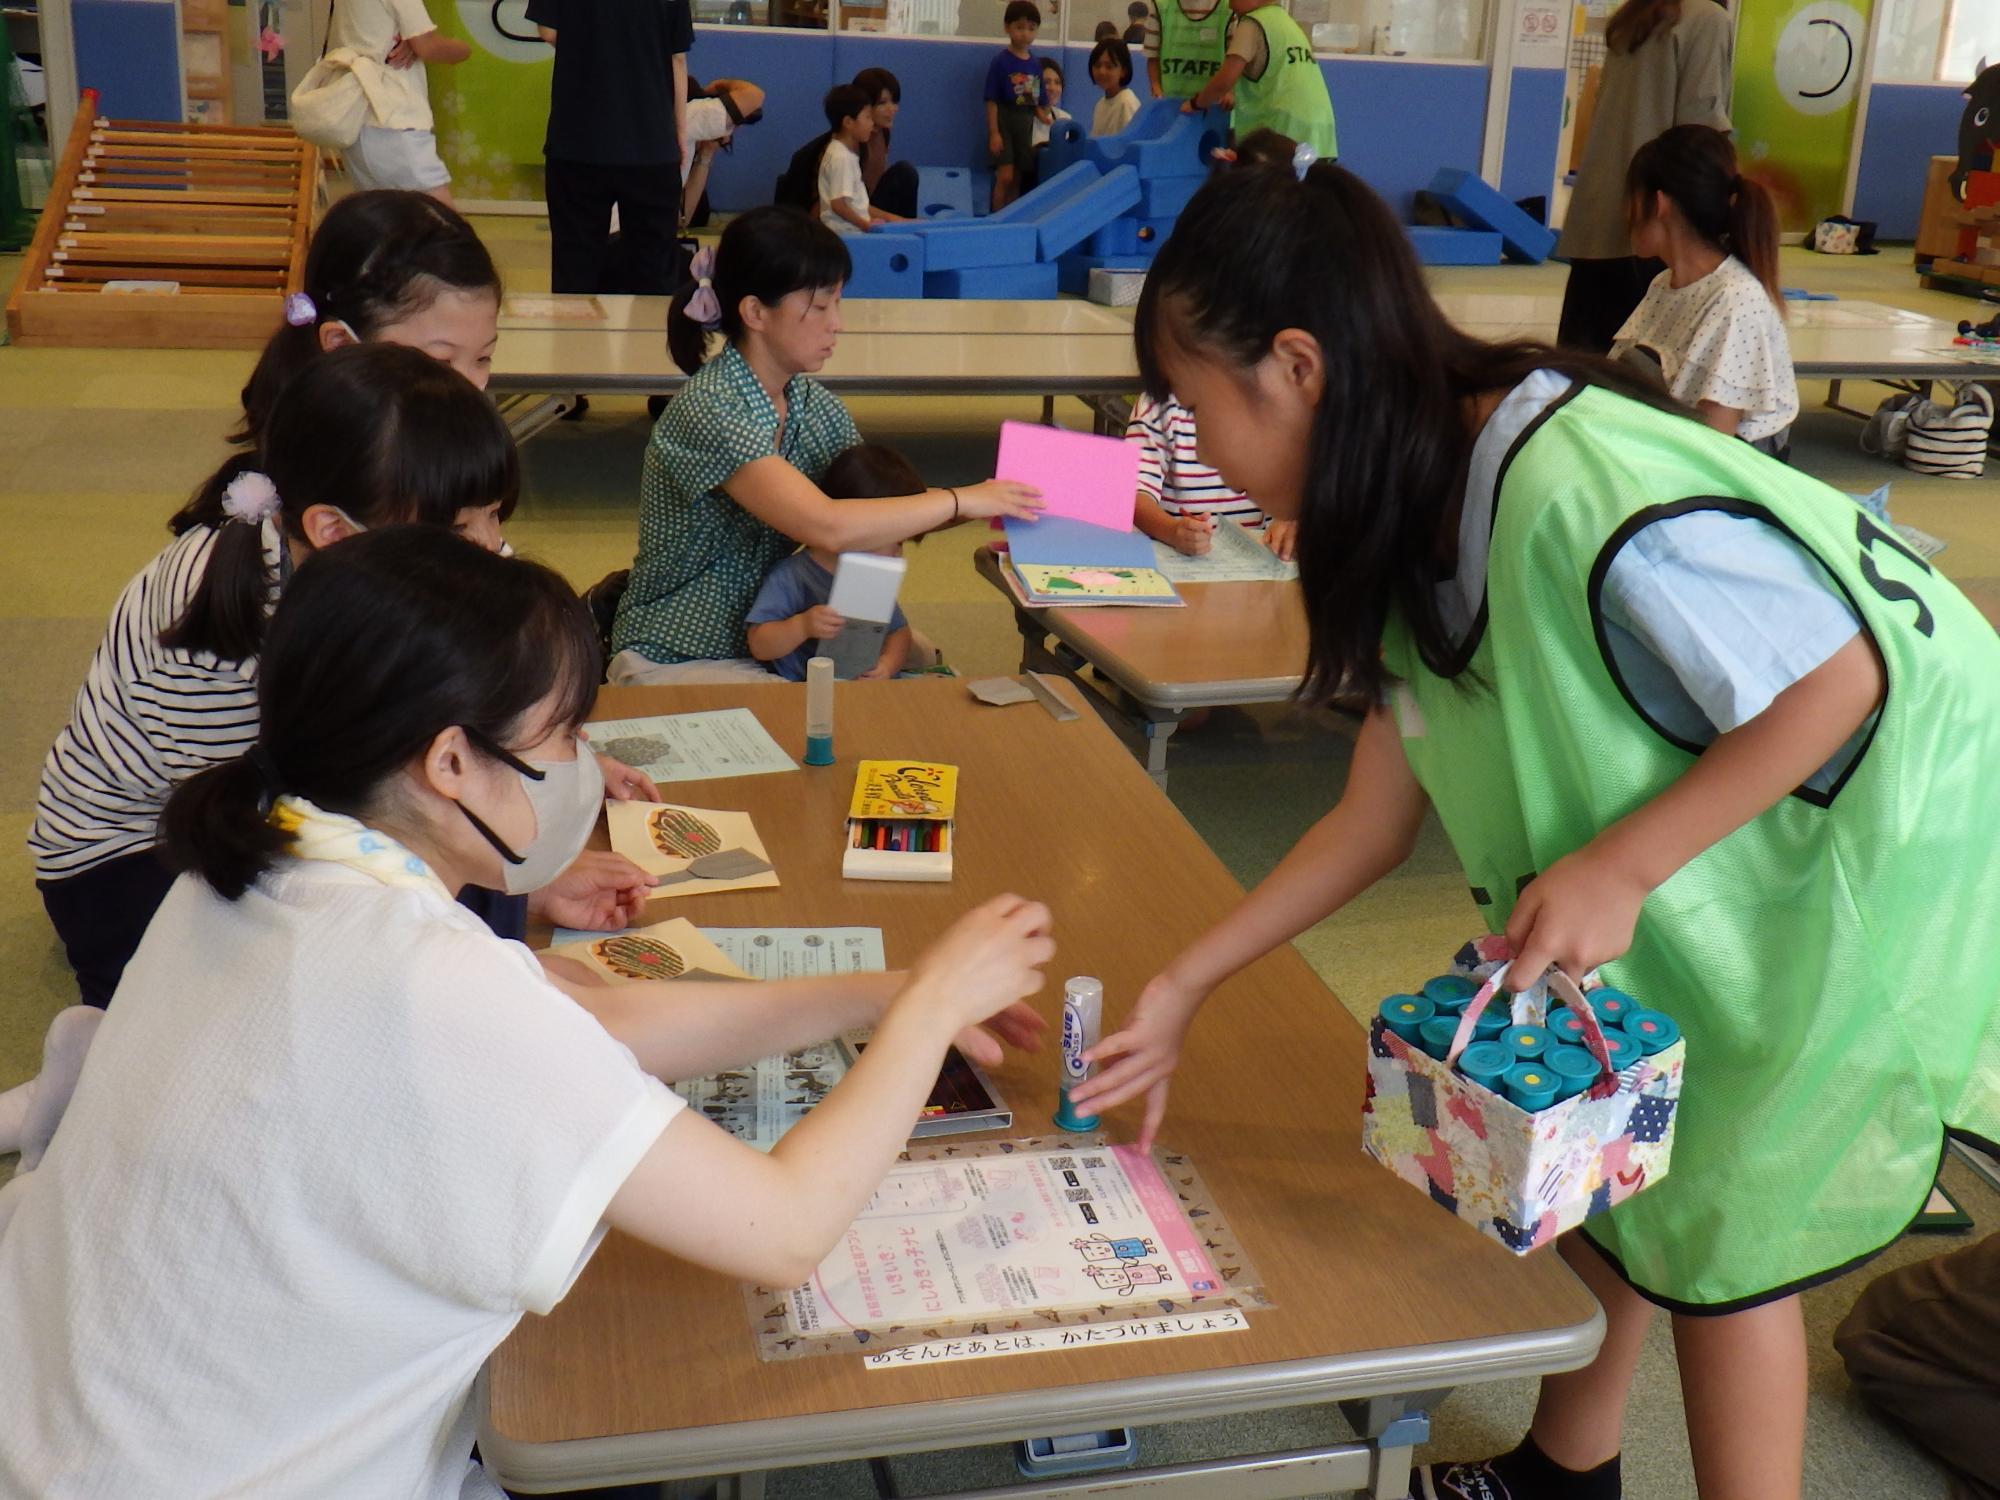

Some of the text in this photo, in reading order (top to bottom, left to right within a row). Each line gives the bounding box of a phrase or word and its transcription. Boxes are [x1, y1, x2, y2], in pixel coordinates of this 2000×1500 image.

[898, 1226, 943, 1313] にしわきっ子ナビ
